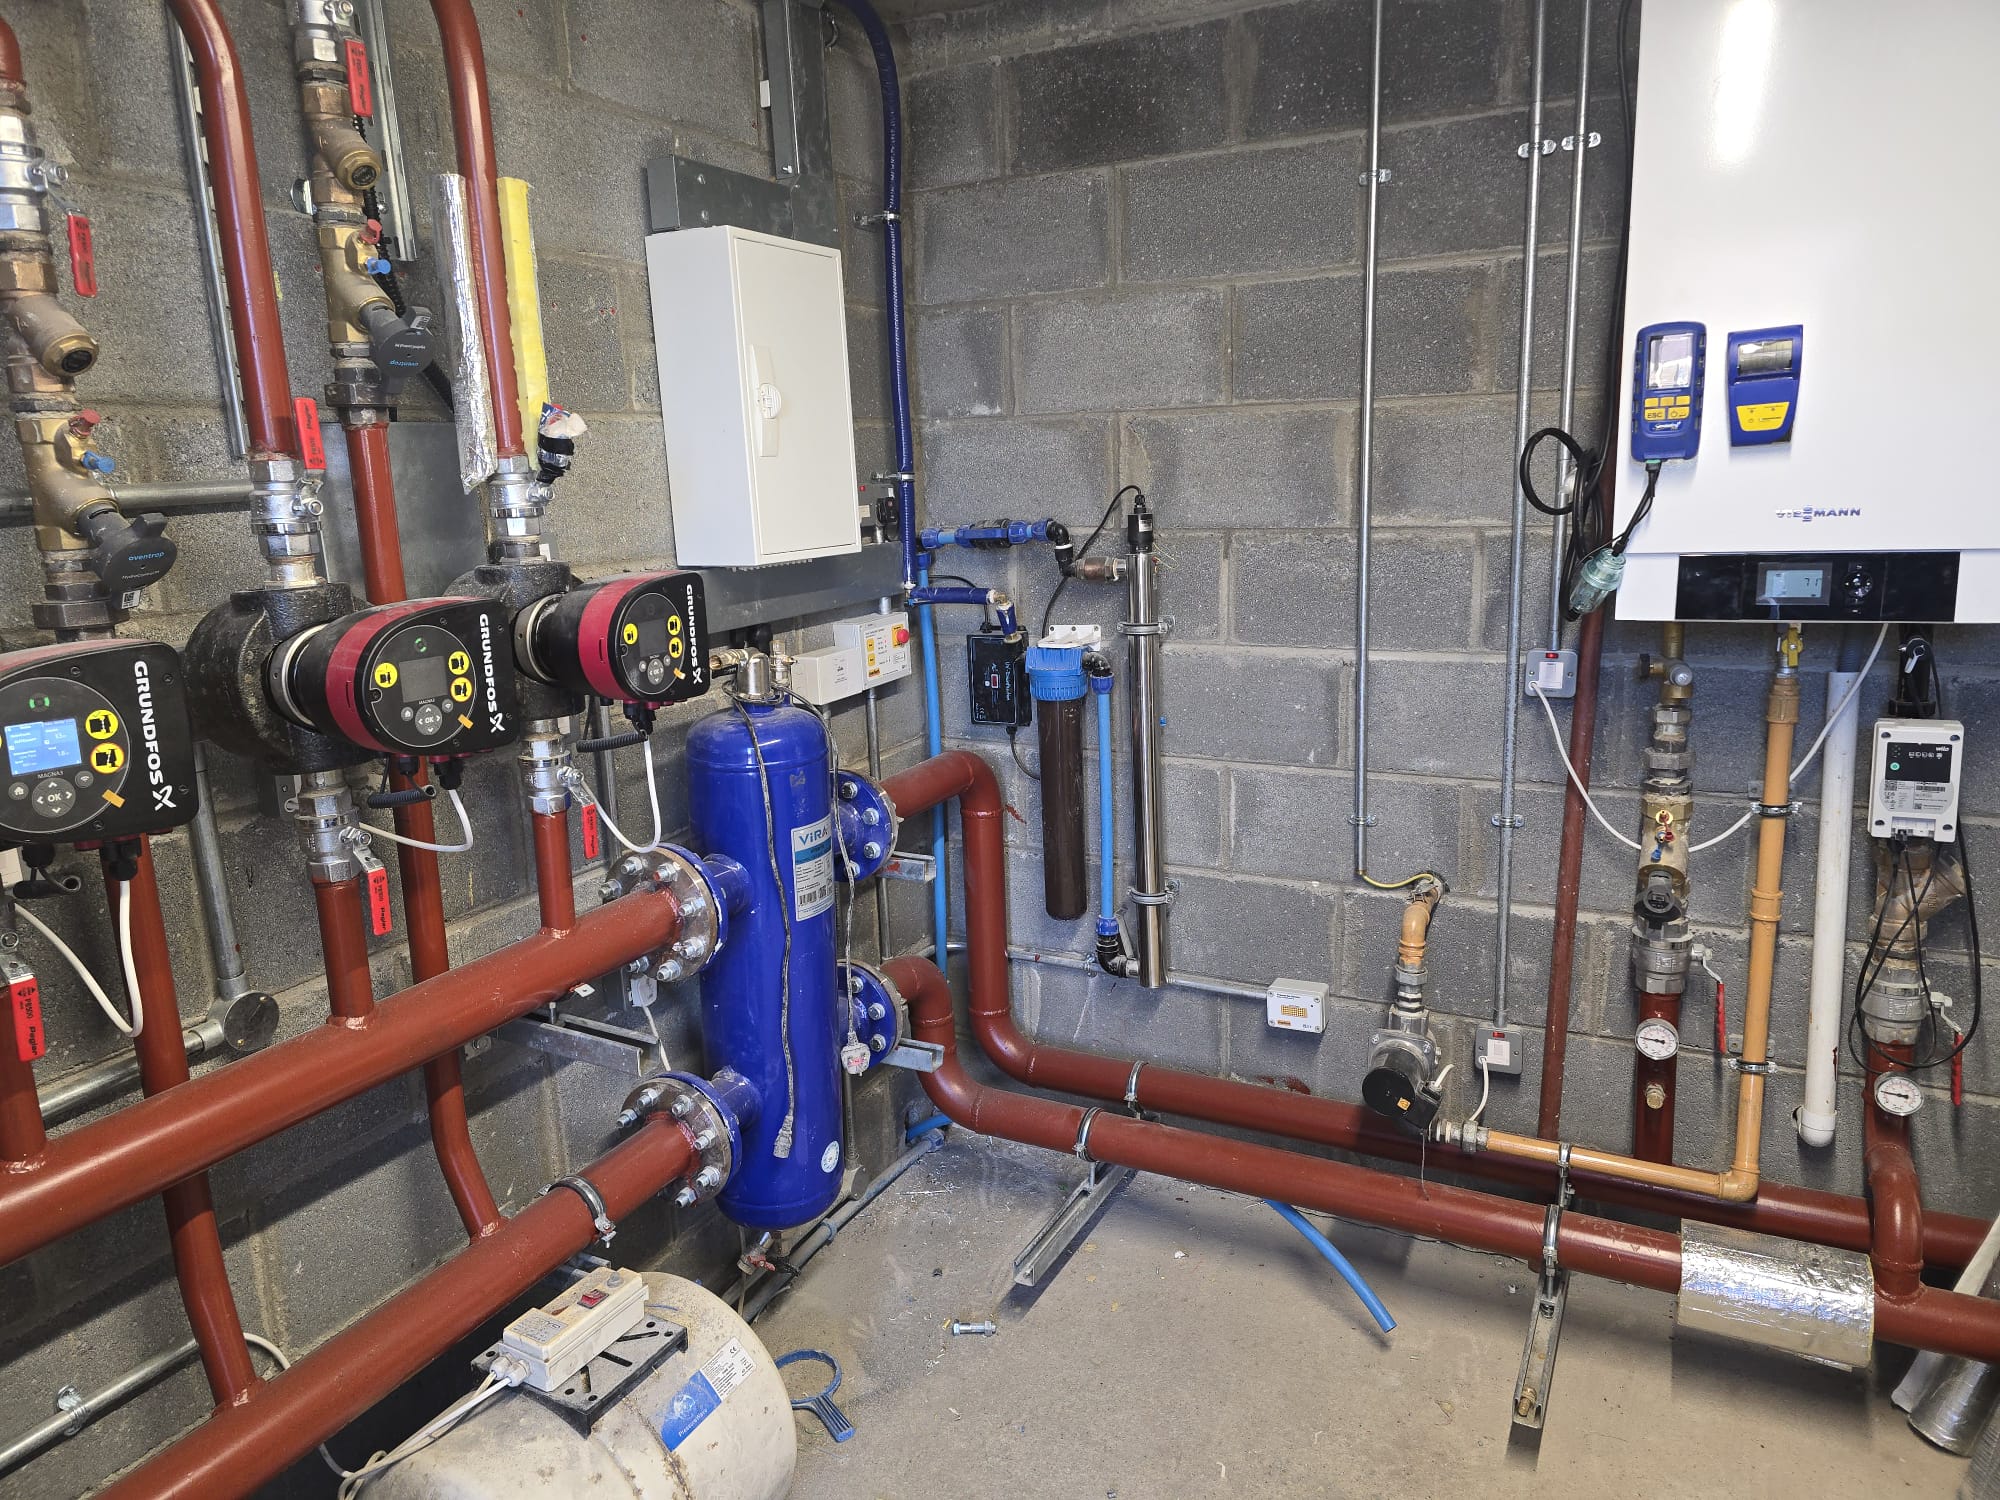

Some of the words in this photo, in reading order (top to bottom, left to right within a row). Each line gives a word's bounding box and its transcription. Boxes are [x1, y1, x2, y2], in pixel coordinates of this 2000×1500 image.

[479, 613, 498, 713] GRUNDFOS
[686, 584, 698, 668] GRUNDFOS
[134, 660, 164, 785] GRUNDFOS
[48, 793, 62, 802] OK
[28, 1026, 38, 1055] Pegler
